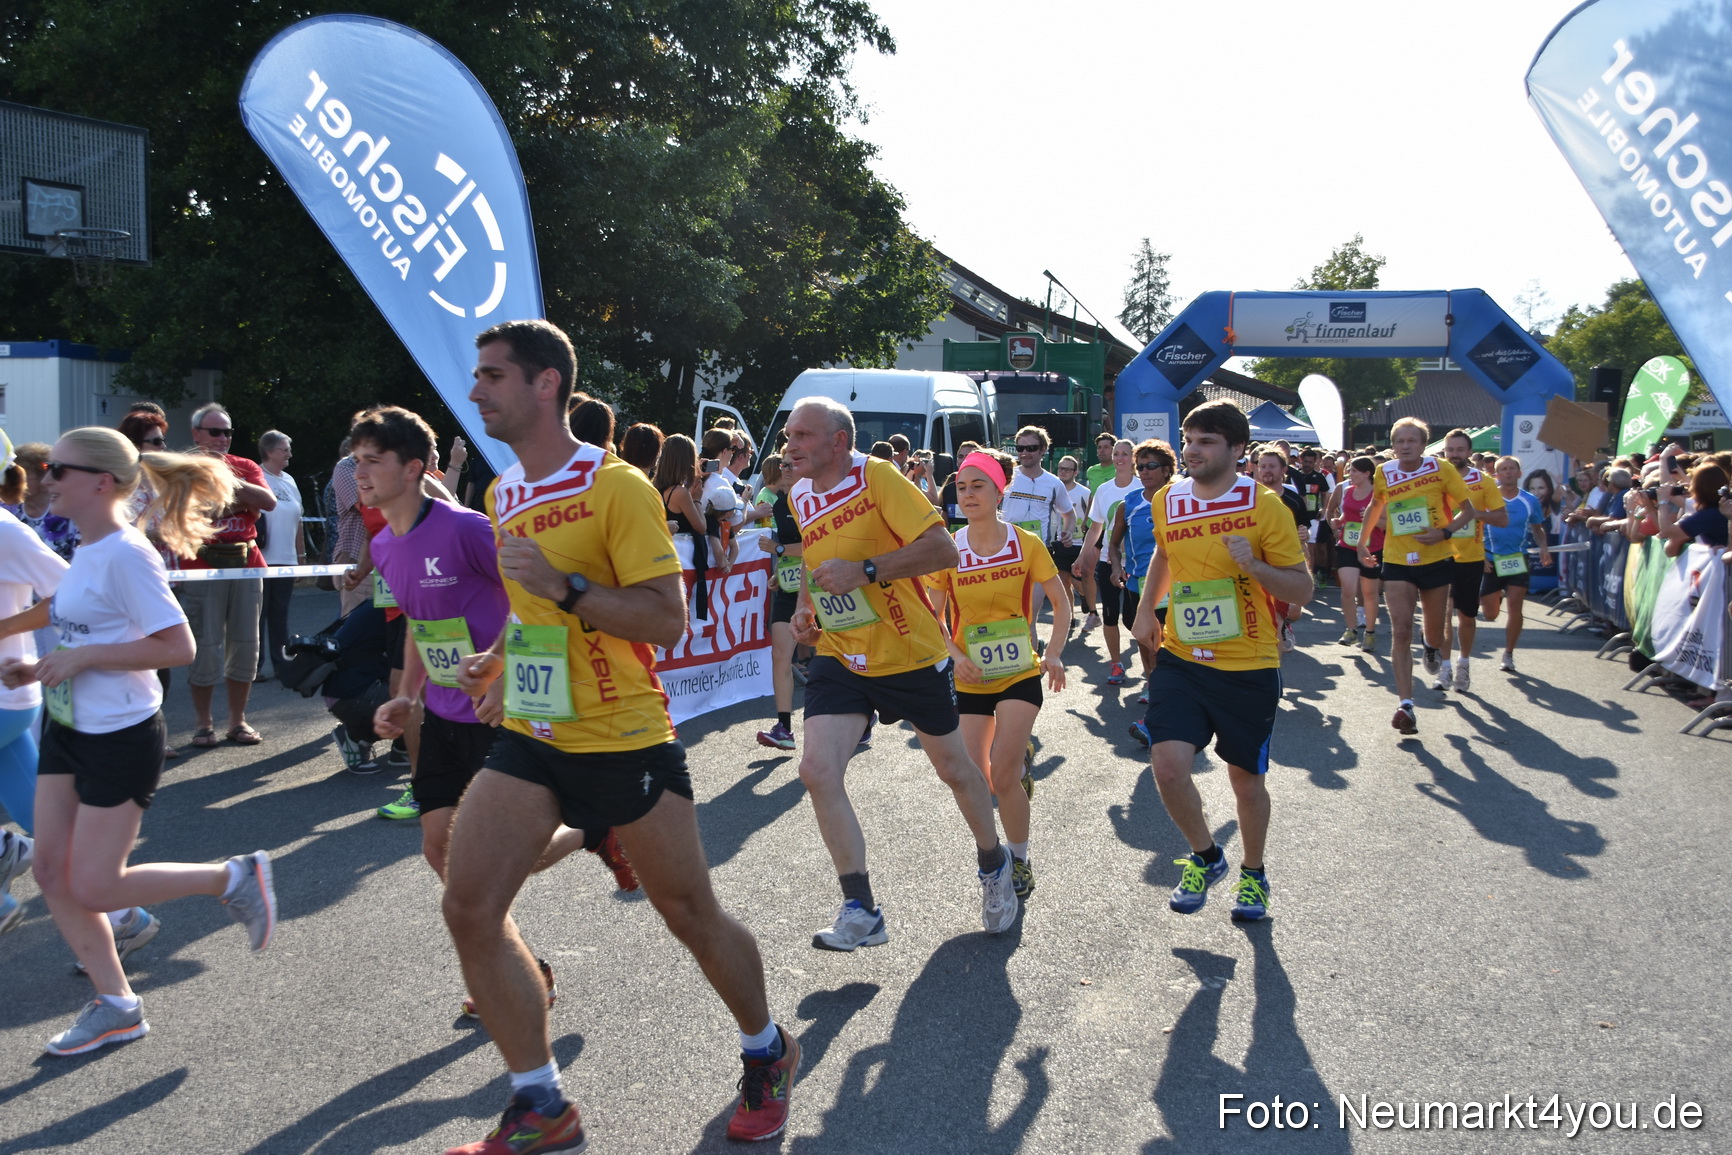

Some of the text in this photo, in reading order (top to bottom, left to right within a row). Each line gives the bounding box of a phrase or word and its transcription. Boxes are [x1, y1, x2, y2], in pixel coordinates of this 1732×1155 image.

[1315, 323, 1398, 338] firmenlauf
[1164, 349, 1207, 360] Fischer
[1652, 392, 1677, 419] AOK
[1622, 411, 1652, 443] AOK
[1388, 475, 1442, 498] MAX BÖGL
[533, 501, 594, 534] BÖGL
[802, 497, 876, 551] MAX BÖGL
[1397, 511, 1422, 526] 946
[1165, 516, 1257, 543] MAX BÖGL
[1348, 531, 1359, 541] 36
[425, 557, 442, 576] K
[957, 573, 987, 587] MAX
[991, 566, 1026, 581] BÖGL
[1501, 560, 1520, 570] 556
[820, 593, 857, 616] 900
[1183, 605, 1223, 628] 921
[426, 647, 460, 669] 694
[980, 642, 1020, 665] 919
[516, 662, 553, 695] 907
